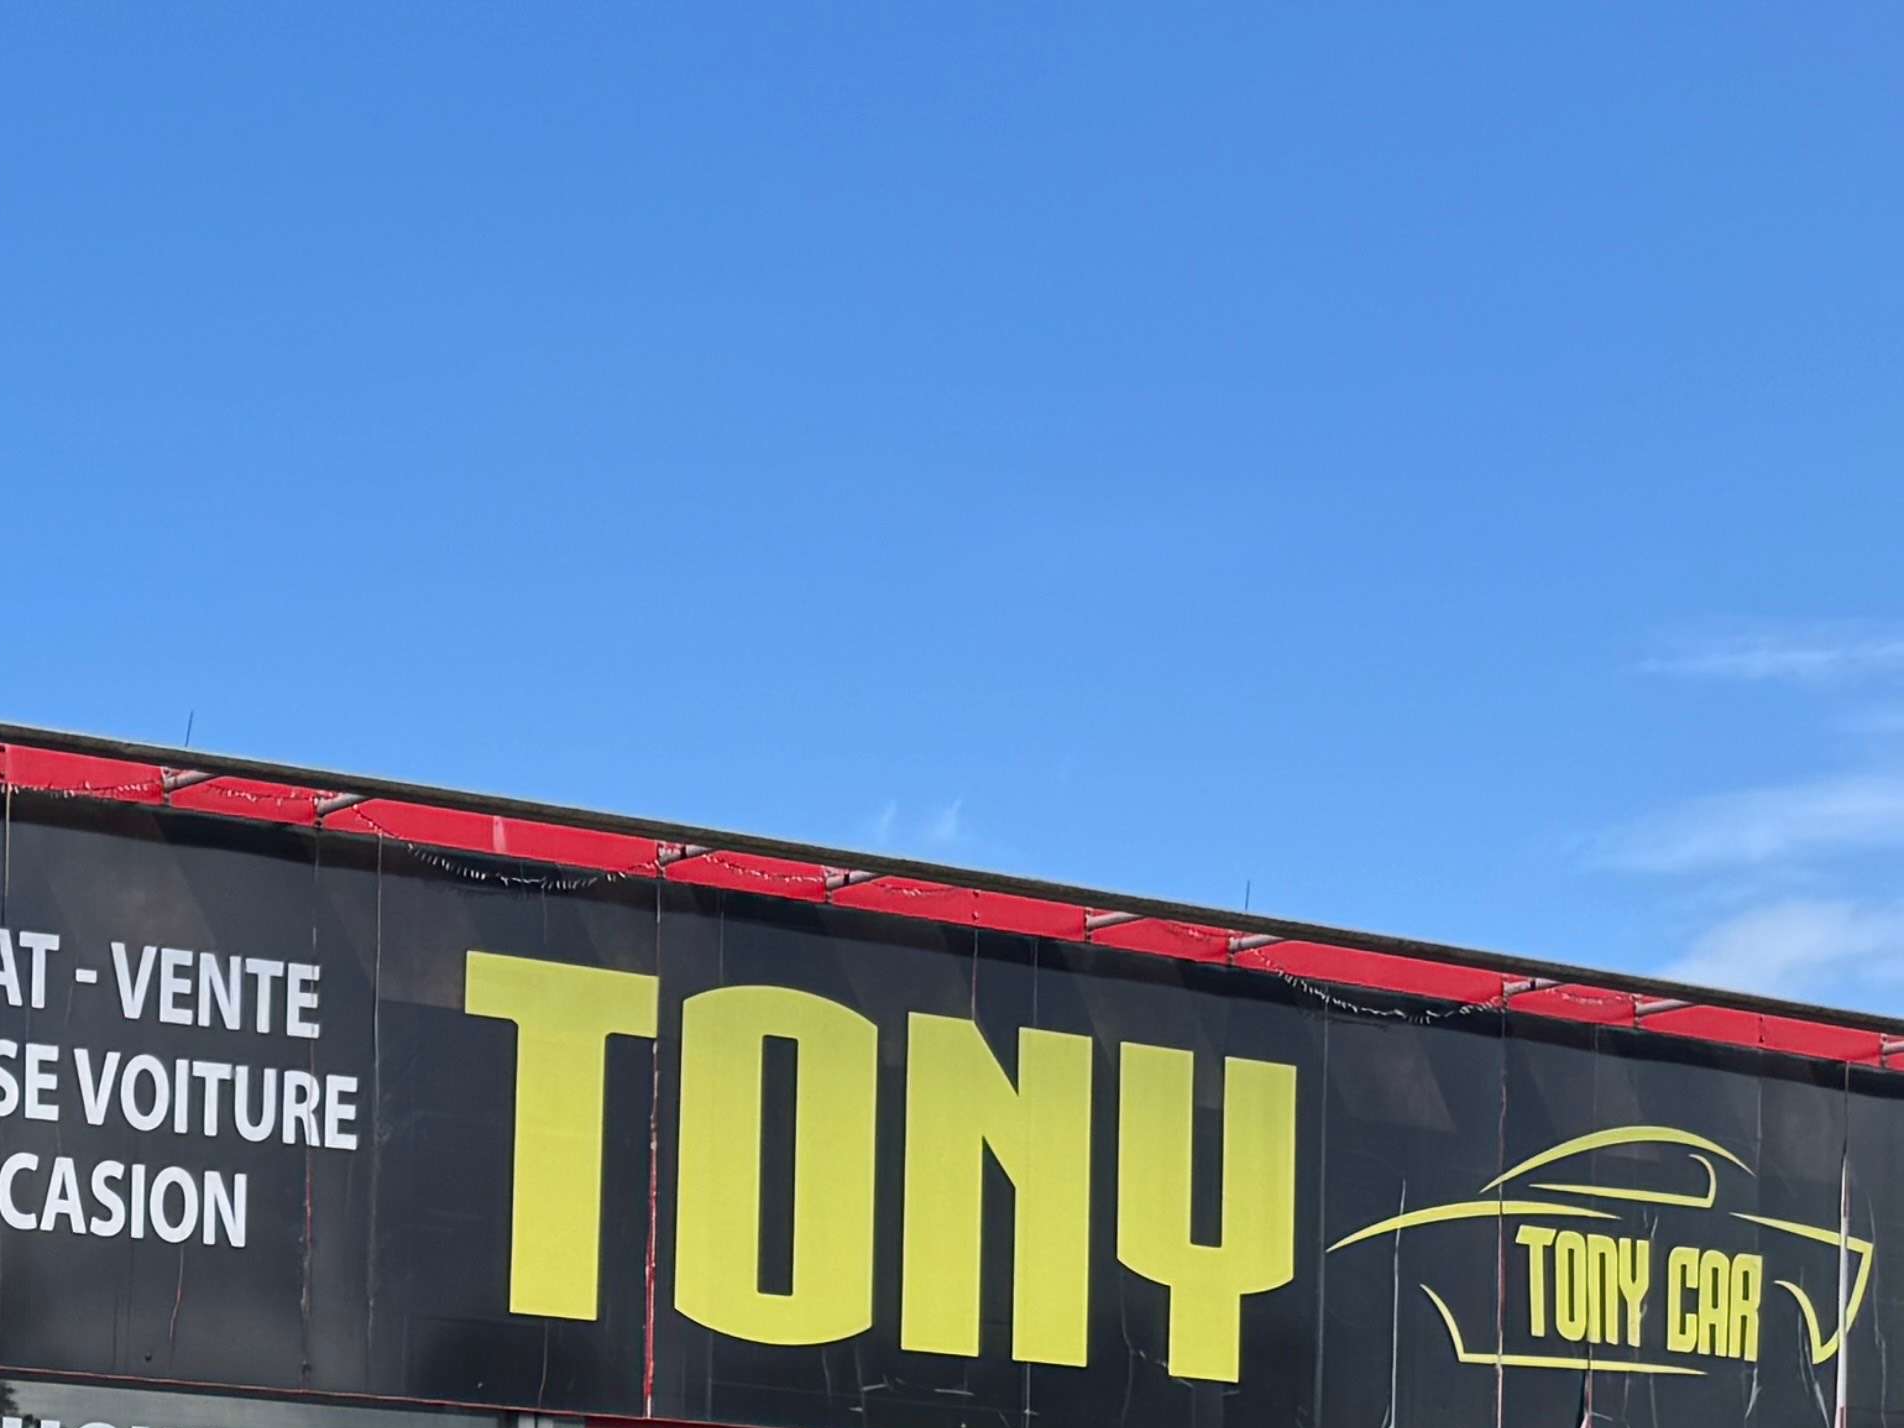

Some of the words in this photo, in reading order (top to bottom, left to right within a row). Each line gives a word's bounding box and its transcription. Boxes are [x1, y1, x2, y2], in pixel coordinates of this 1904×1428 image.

[111, 942, 321, 1039] VENTE
[73, 1048, 358, 1150] VOITURE
[465, 951, 1297, 1382] TONY
[1515, 1224, 1649, 1347] TONY
[1667, 1246, 1763, 1362] CAR
